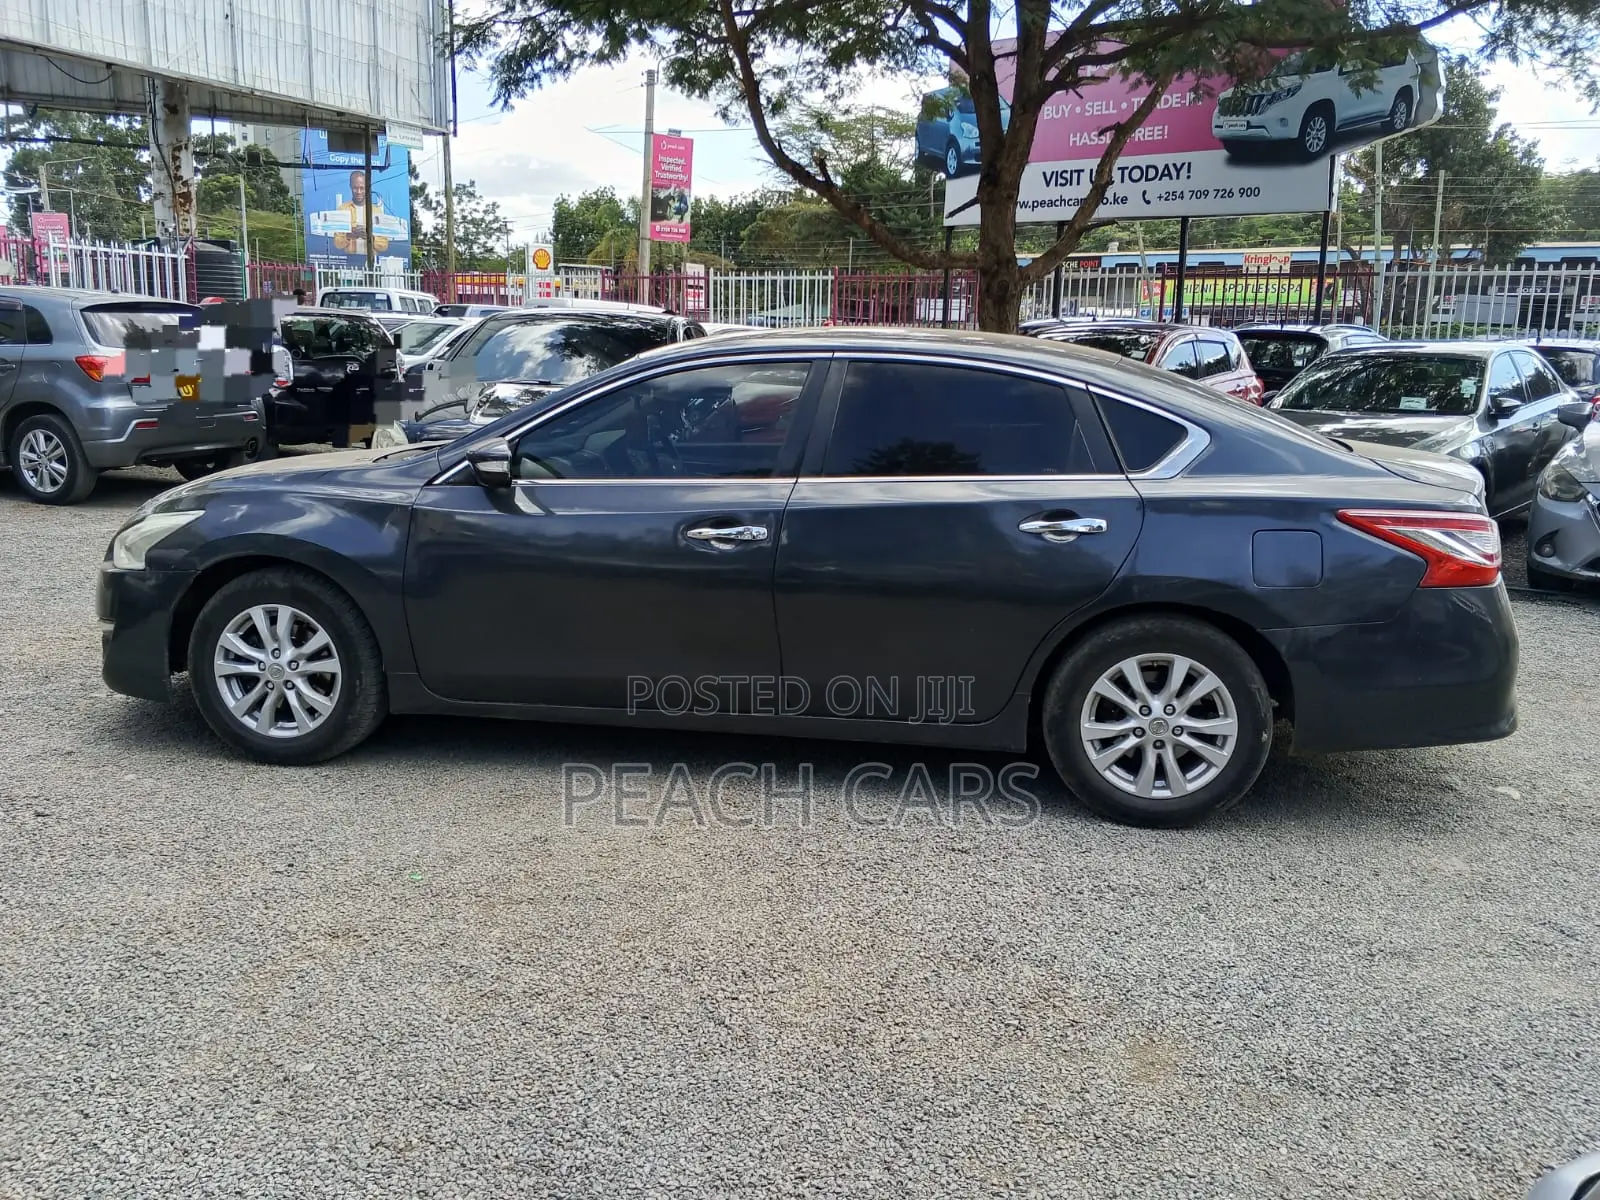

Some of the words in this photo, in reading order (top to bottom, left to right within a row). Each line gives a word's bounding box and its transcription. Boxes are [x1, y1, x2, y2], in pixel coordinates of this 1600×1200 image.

[1043, 103, 1072, 120] BUY
[1084, 100, 1117, 116] SELL
[1069, 130, 1114, 147] HASSL
[1127, 125, 1168, 142] REE!
[329, 153, 348, 164] Copy
[350, 156, 363, 165] the
[654, 170, 689, 182] Trustworthy!
[1042, 168, 1085, 188] VISIT
[1117, 161, 1193, 185] TODAY!
[1157, 190, 1185, 202] +254
[1188, 189, 1210, 201] 709
[1213, 187, 1235, 200] 726
[1238, 186, 1261, 198] 900
[1079, 260, 1099, 269] POINT
